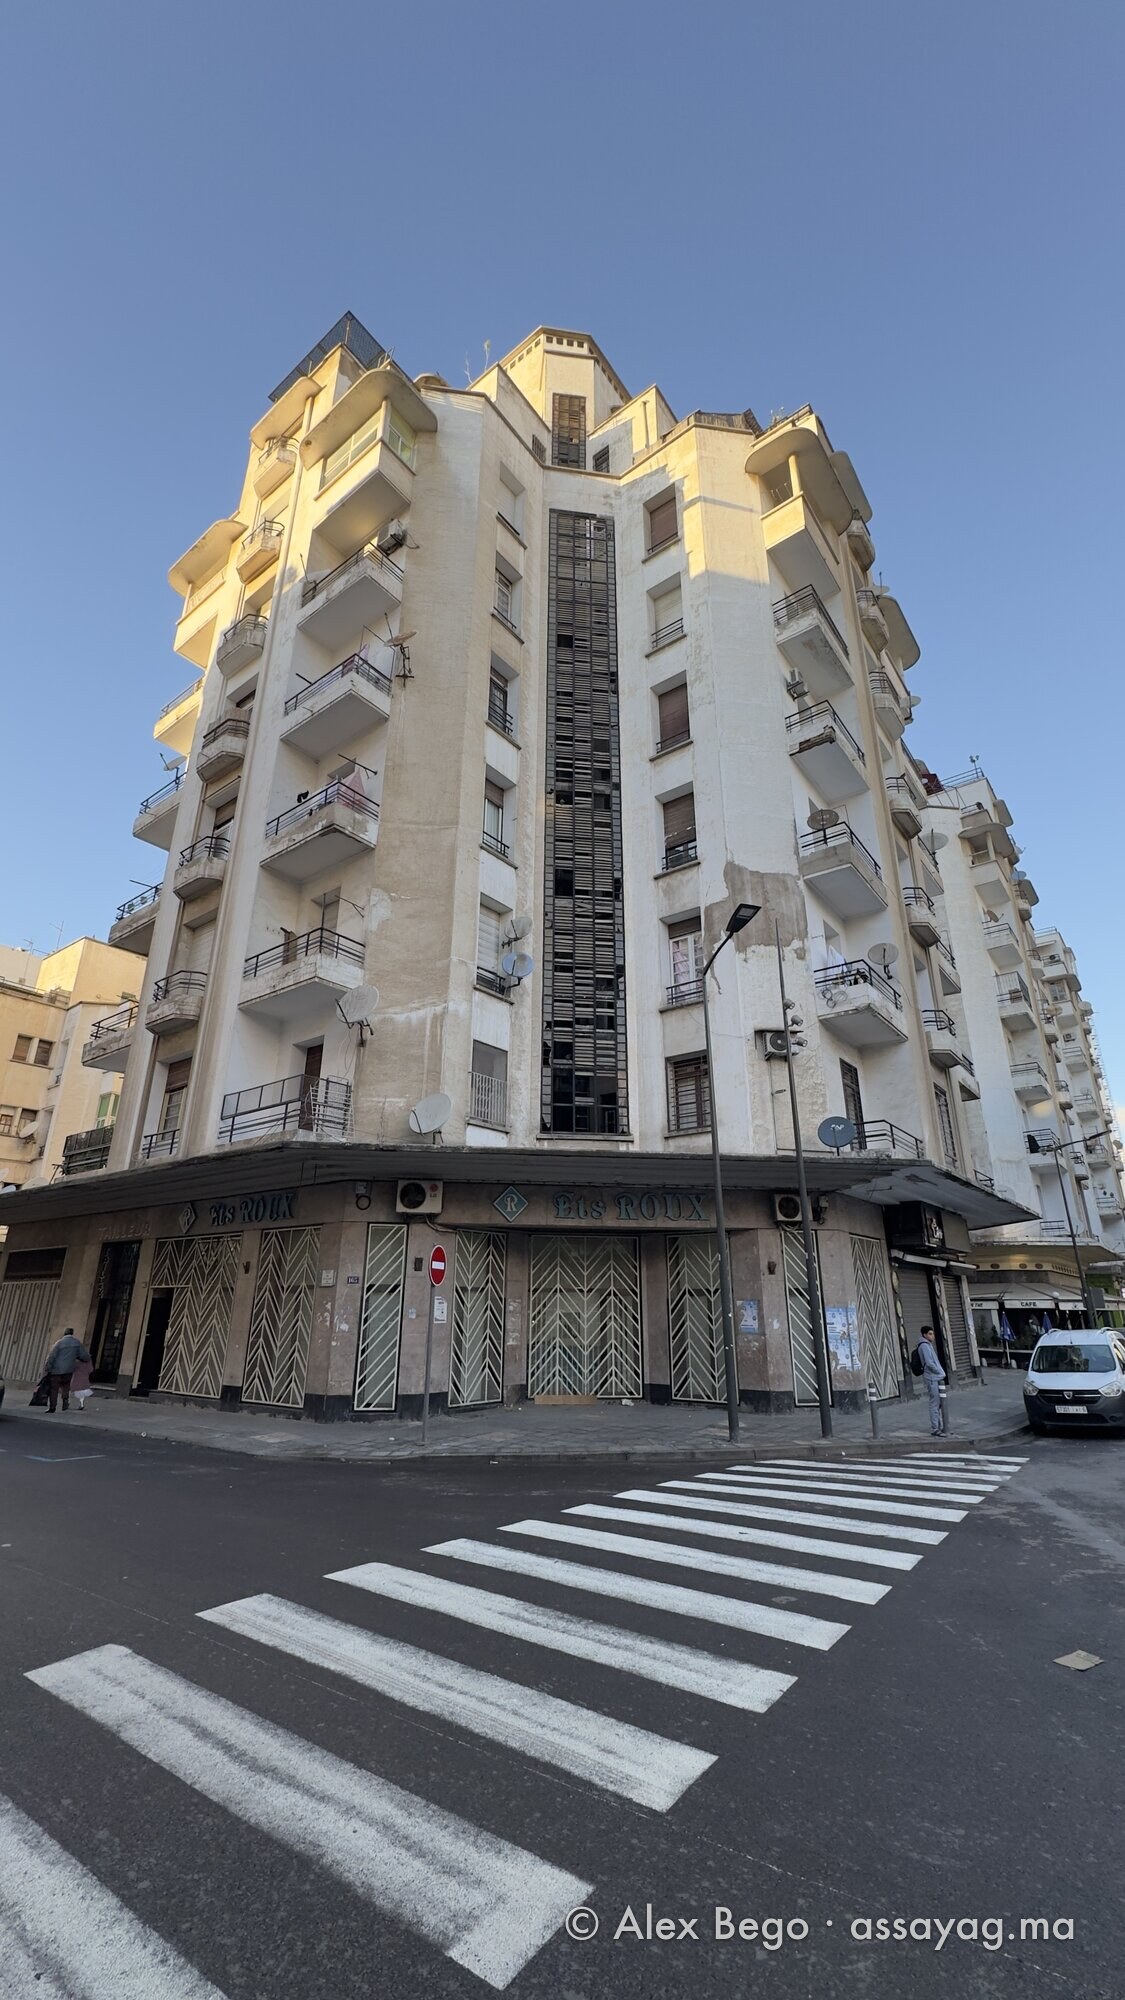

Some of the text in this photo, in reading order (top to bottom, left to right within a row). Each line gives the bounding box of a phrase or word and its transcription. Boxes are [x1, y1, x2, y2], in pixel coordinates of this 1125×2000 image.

[209, 1193, 294, 1226] Ets ROUX
[504, 1194, 518, 1212] R
[554, 1192, 709, 1221] Ets ROUX
